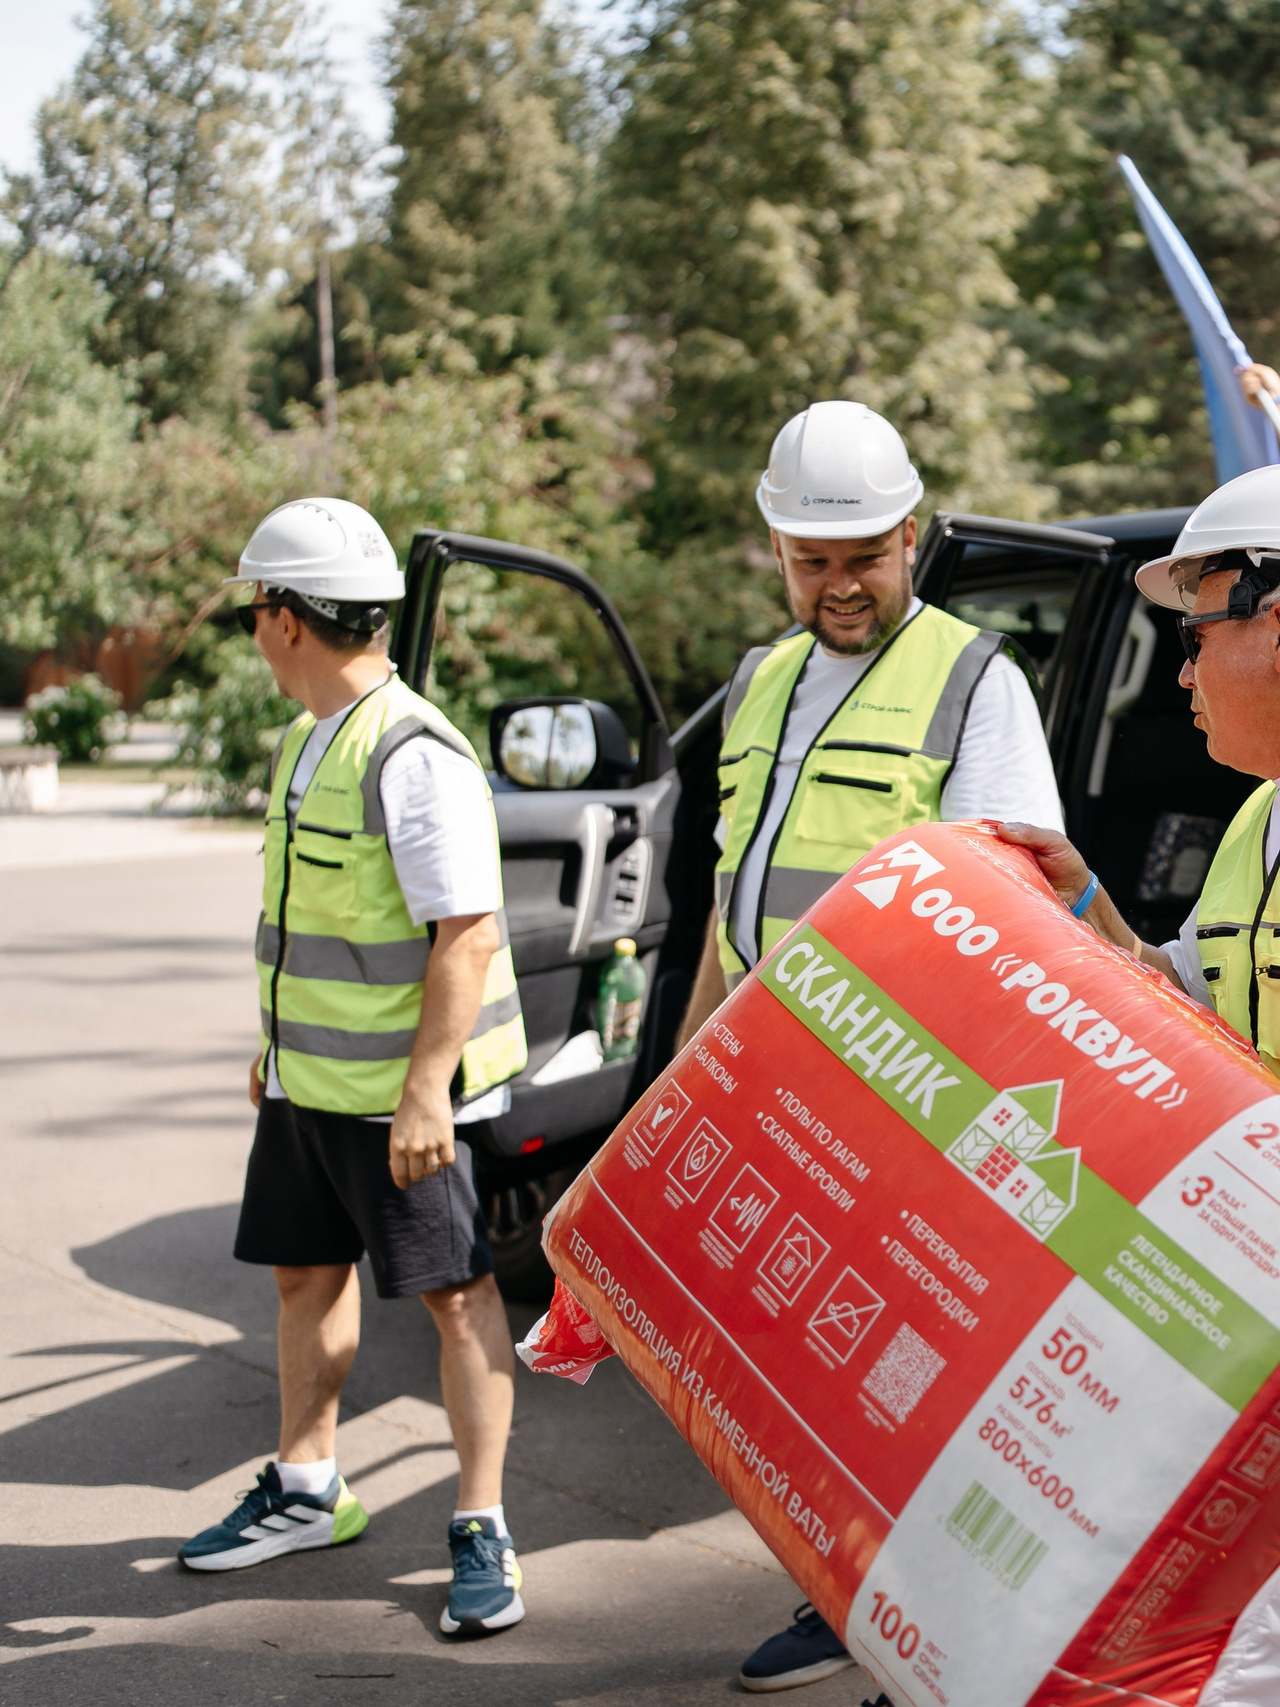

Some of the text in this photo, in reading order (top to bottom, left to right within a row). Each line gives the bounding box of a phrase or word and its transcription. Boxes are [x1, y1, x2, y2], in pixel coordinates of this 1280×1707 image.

[775, 942, 962, 1120] СКАНДИК
[911, 888, 1188, 1110] ООО «РОКВУЛ»
[695, 1046, 739, 1094] БАЛКОНЫ
[713, 1023, 744, 1058] СТЕНЫ
[761, 1115, 856, 1213] СКАТНЫЕ КРОВЛИ
[779, 1090, 871, 1183] ПОЛЫ ПО ЛАГАМ
[905, 1213, 990, 1296] ПЕРЕКРЫТИЯ
[1197, 1208, 1212, 1223] ЗА
[1210, 1218, 1239, 1243] ОДНУ
[1206, 1198, 1279, 1259] БОЛЬШЕ ПАЧЕК
[885, 1239, 980, 1333] ПЕРЕГОРОДКИ
[1103, 1264, 1170, 1325] КАЧЕСТВО
[1117, 1249, 1232, 1351] СКАНДИНАВСКОЕ
[1129, 1233, 1224, 1315] ЛЕГЕНДАРНОЕ
[1041, 1325, 1088, 1375] 50
[568, 1227, 682, 1375] ТЕПЛОИЗОЛЯЦИЯ
[681, 1361, 704, 1398] ИЗ
[702, 1387, 789, 1504] КАМЕННОЙ
[785, 1492, 837, 1558] ВАТЫ
[1009, 1374, 1057, 1424] 5,76
[870, 1592, 921, 1660] 100
[918, 1652, 943, 1679] СРОК
